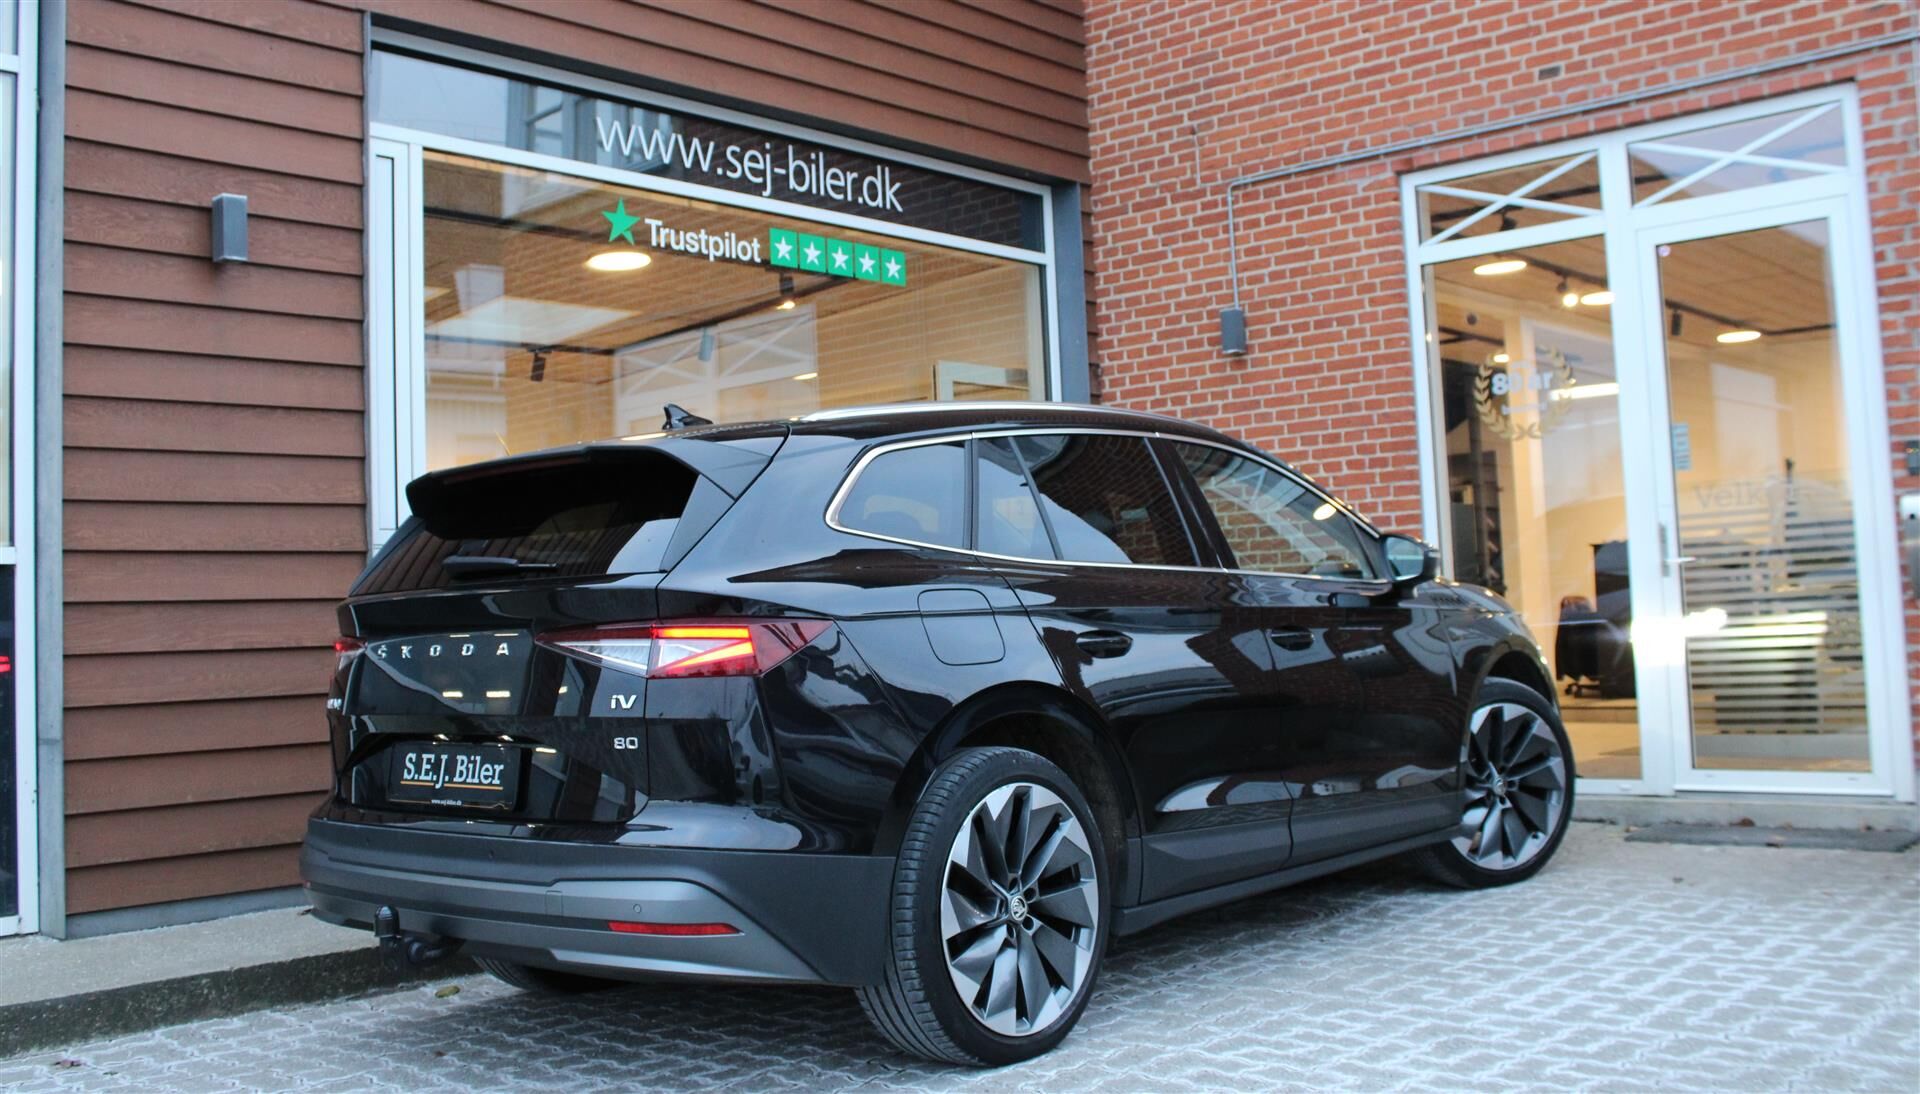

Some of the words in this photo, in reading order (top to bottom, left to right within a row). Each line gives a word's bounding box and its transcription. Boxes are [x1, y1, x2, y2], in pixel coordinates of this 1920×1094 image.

[596, 116, 904, 213] www.sej-biler.dk
[644, 217, 762, 263] Trustpilot
[613, 736, 639, 750] 80
[403, 753, 450, 789] S.E.J.
[453, 755, 504, 786] Biler
